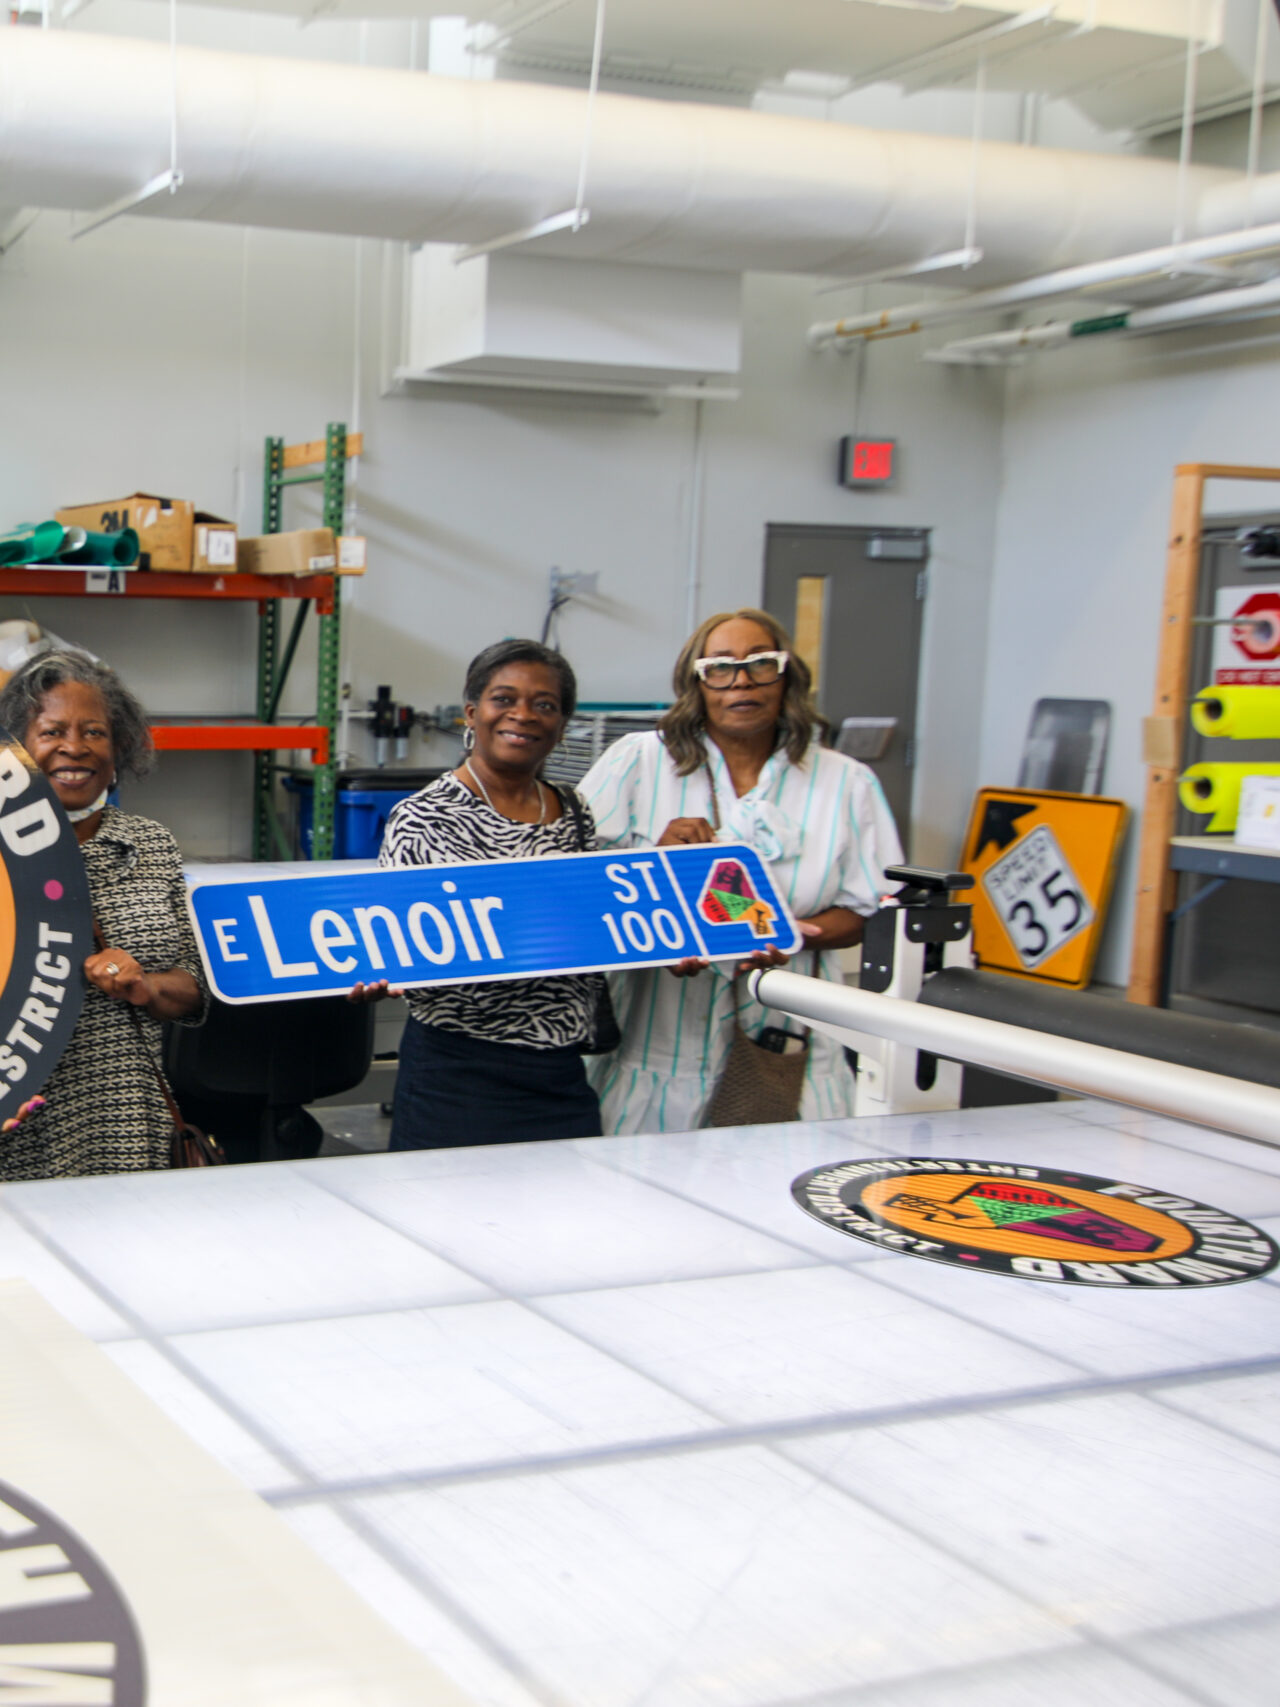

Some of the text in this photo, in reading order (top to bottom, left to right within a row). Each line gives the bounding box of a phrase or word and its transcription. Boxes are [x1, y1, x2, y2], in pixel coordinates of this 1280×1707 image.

[605, 860, 660, 905] ST
[990, 836, 1047, 890] SPEED
[211, 880, 504, 980] E Lenoir
[601, 908, 687, 955] 100
[1007, 869, 1081, 957] 35
[807, 1193, 945, 1252] DISTRICT
[1096, 1183, 1272, 1268] FOURTH
[1010, 1256, 1250, 1285] WARD
